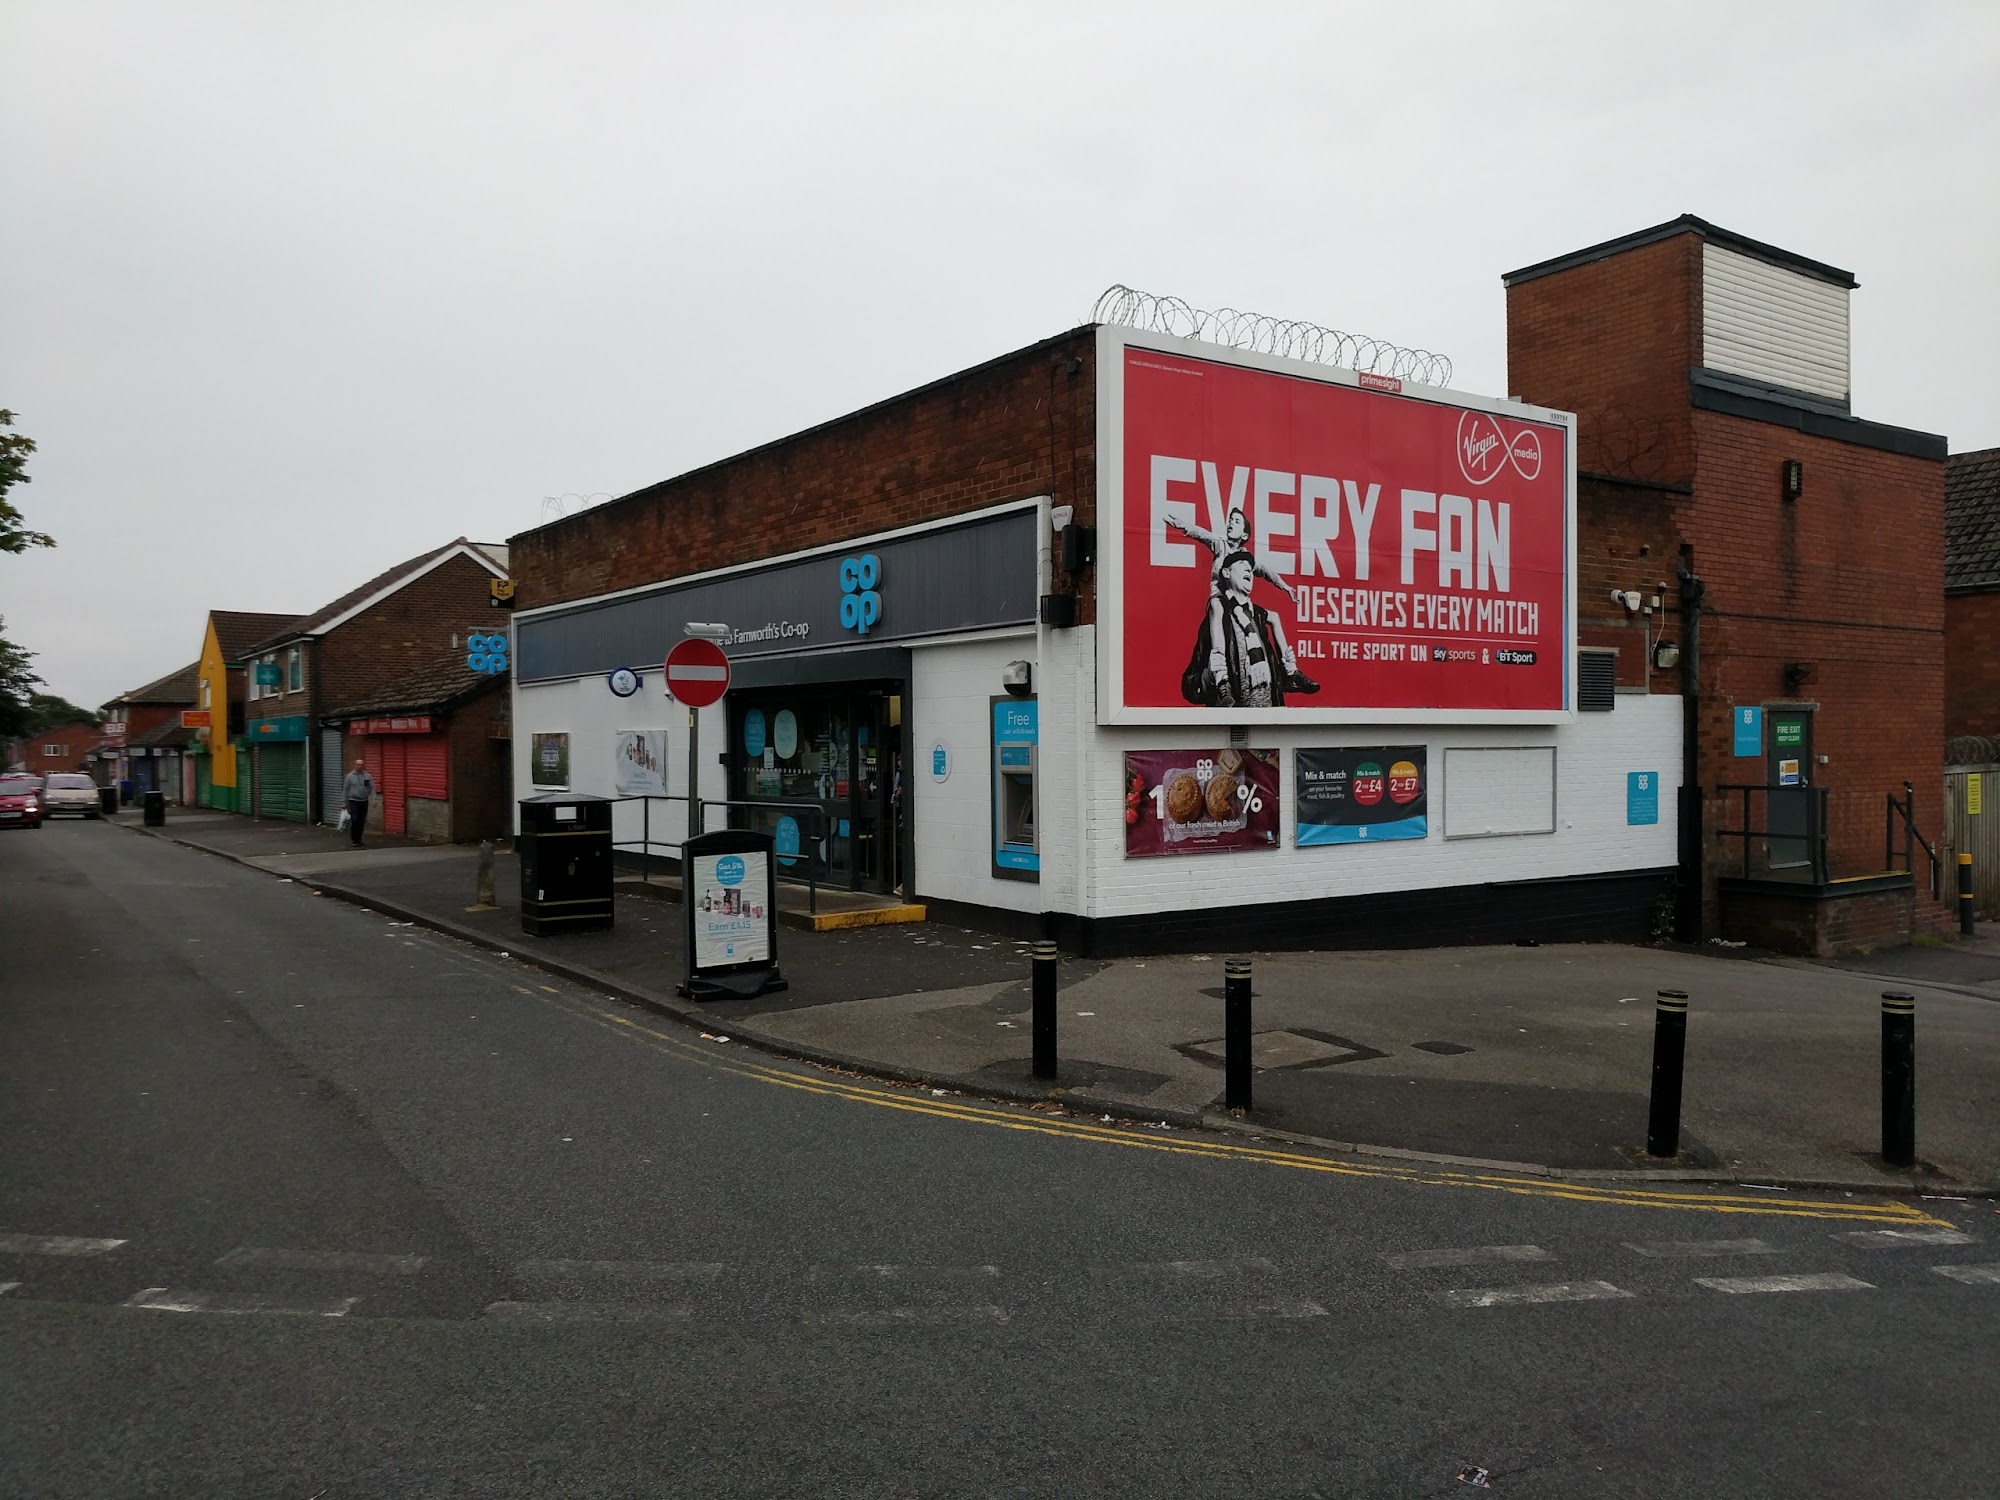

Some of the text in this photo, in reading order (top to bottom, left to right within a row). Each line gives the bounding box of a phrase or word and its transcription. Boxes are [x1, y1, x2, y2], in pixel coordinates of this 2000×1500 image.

[1361, 375, 1400, 390] primesight
[1463, 420, 1499, 471] Virgin
[1514, 448, 1538, 460] media
[1150, 454, 1511, 593] EVERY FAN
[1297, 585, 1538, 635] DESERVES EVERY MATCH
[734, 622, 780, 644] Farnworth's
[781, 621, 809, 640] Co-op
[1298, 640, 1533, 664] ALL THE SPORT ON sky sports & BT Sport
[1007, 710, 1030, 726] Free
[1777, 725, 1801, 733] FIRE EXIT
[1305, 770, 1346, 780] Mix & match
[1355, 779, 1362, 793] 2
[1369, 779, 1382, 792] £4
[1390, 779, 1397, 792] 2
[1404, 778, 1416, 791] £7
[1318, 792, 1326, 800] fish
[1330, 792, 1345, 801] poultry
[1187, 820, 1201, 829] fresh
[1223, 819, 1241, 827] British
[708, 920, 751, 931] Earn £1.15
